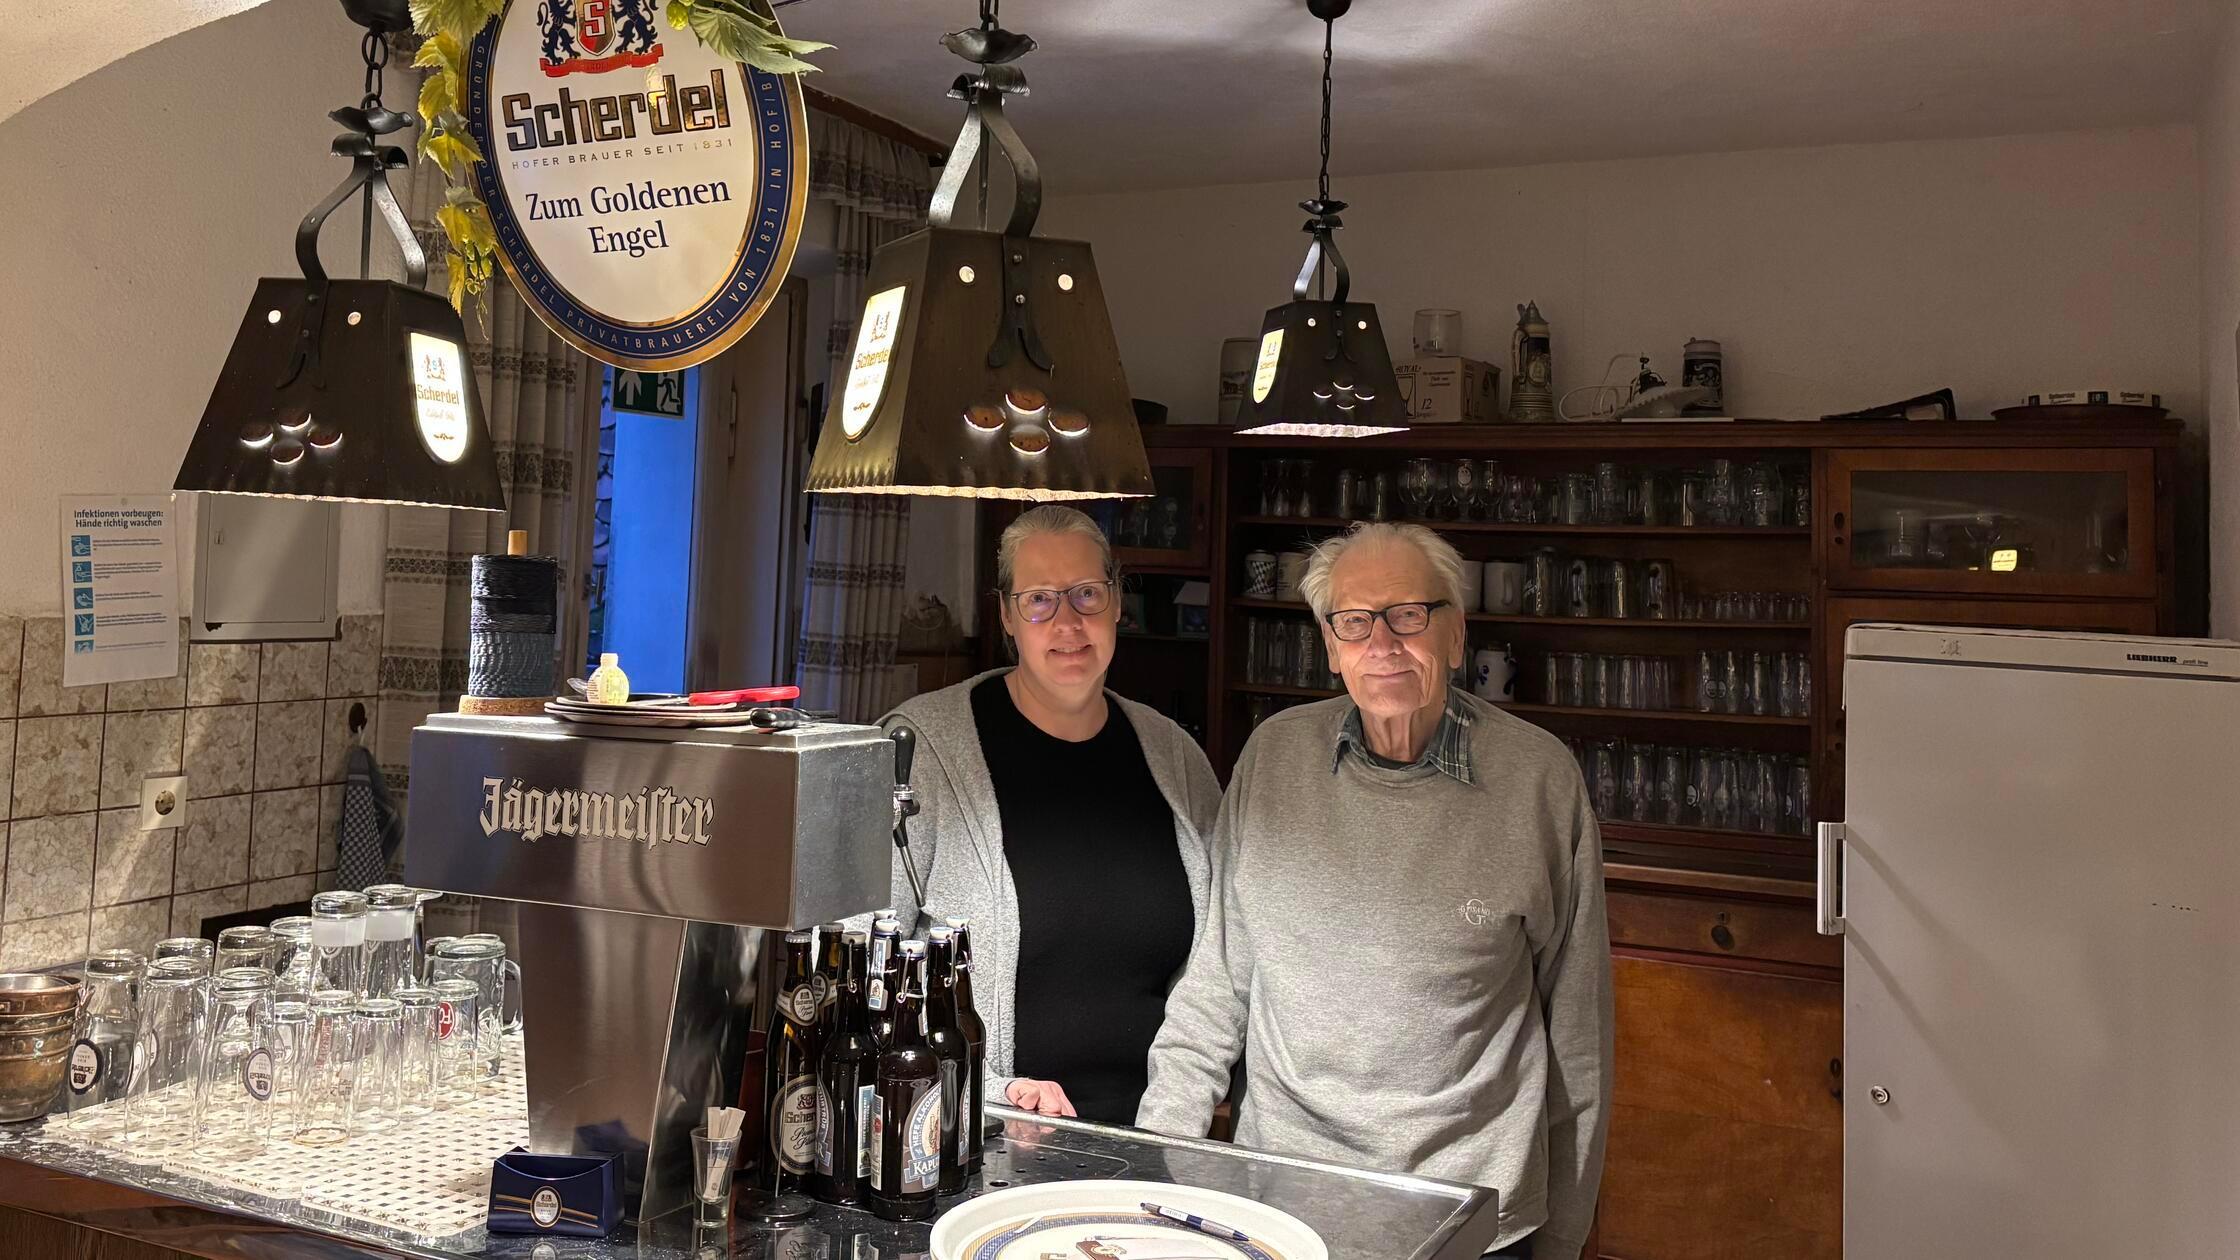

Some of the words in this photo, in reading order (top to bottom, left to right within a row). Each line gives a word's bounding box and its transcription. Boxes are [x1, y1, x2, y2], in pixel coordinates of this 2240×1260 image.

[584, 1, 605, 37] S
[502, 68, 731, 152] Scherdel
[512, 157, 560, 170] HOFER
[568, 149, 633, 163] BRAUER
[644, 143, 684, 156] SEIT
[693, 138, 733, 151] 1831
[525, 193, 584, 221] Zum
[591, 179, 732, 214] Goldenen
[480, 160, 496, 197] DER
[496, 212, 555, 305] SCHERDEL
[566, 309, 725, 349] PRIVATBRAUEREI
[728, 268, 757, 303] VON
[756, 207, 778, 255] 1831
[769, 168, 782, 189] IN
[587, 220, 670, 258] Engel
[416, 383, 460, 405] Scherdel
[74, 509, 120, 518] Infektionen
[121, 509, 164, 520] vorbeugen:
[75, 519, 102, 528] Hände
[103, 519, 129, 529] richtig
[129, 519, 162, 527] waschen
